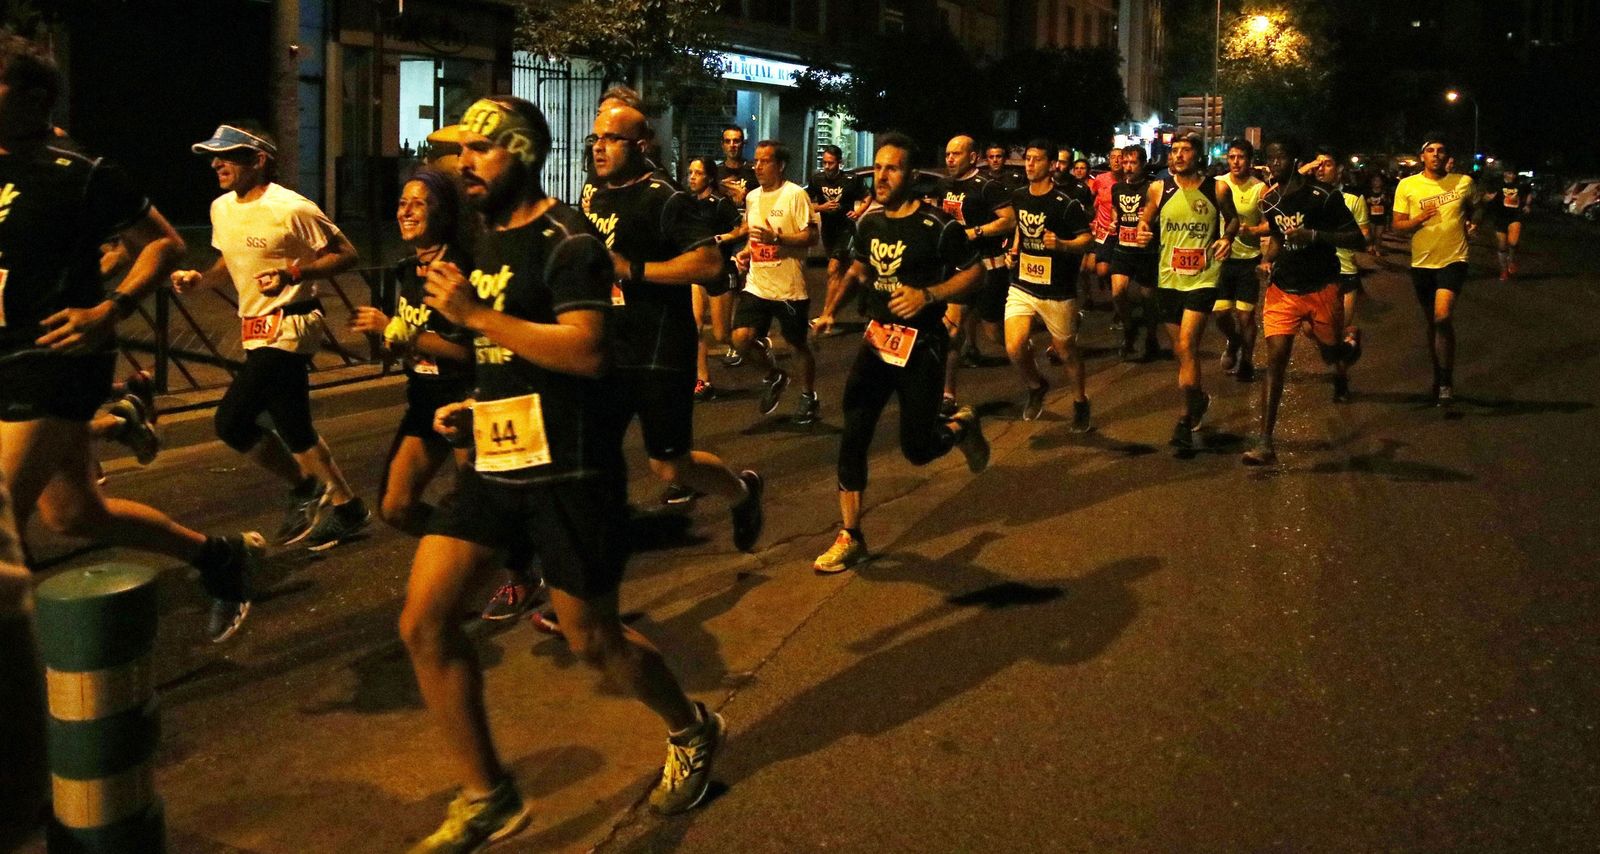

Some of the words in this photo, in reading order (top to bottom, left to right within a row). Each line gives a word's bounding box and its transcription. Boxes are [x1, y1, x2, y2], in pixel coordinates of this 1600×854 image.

[822, 186, 843, 197] Rock
[945, 191, 965, 202] Rock
[1119, 193, 1141, 205] Rock
[770, 209, 784, 217] SGS
[1019, 209, 1046, 226] Rock
[1274, 212, 1305, 231] Rock
[246, 237, 267, 248] SGS
[870, 238, 907, 261] Rock
[1179, 255, 1200, 266] 312
[1027, 263, 1045, 275] 649
[399, 296, 432, 326] Rock
[883, 334, 900, 350] 76
[490, 419, 517, 447] 44
